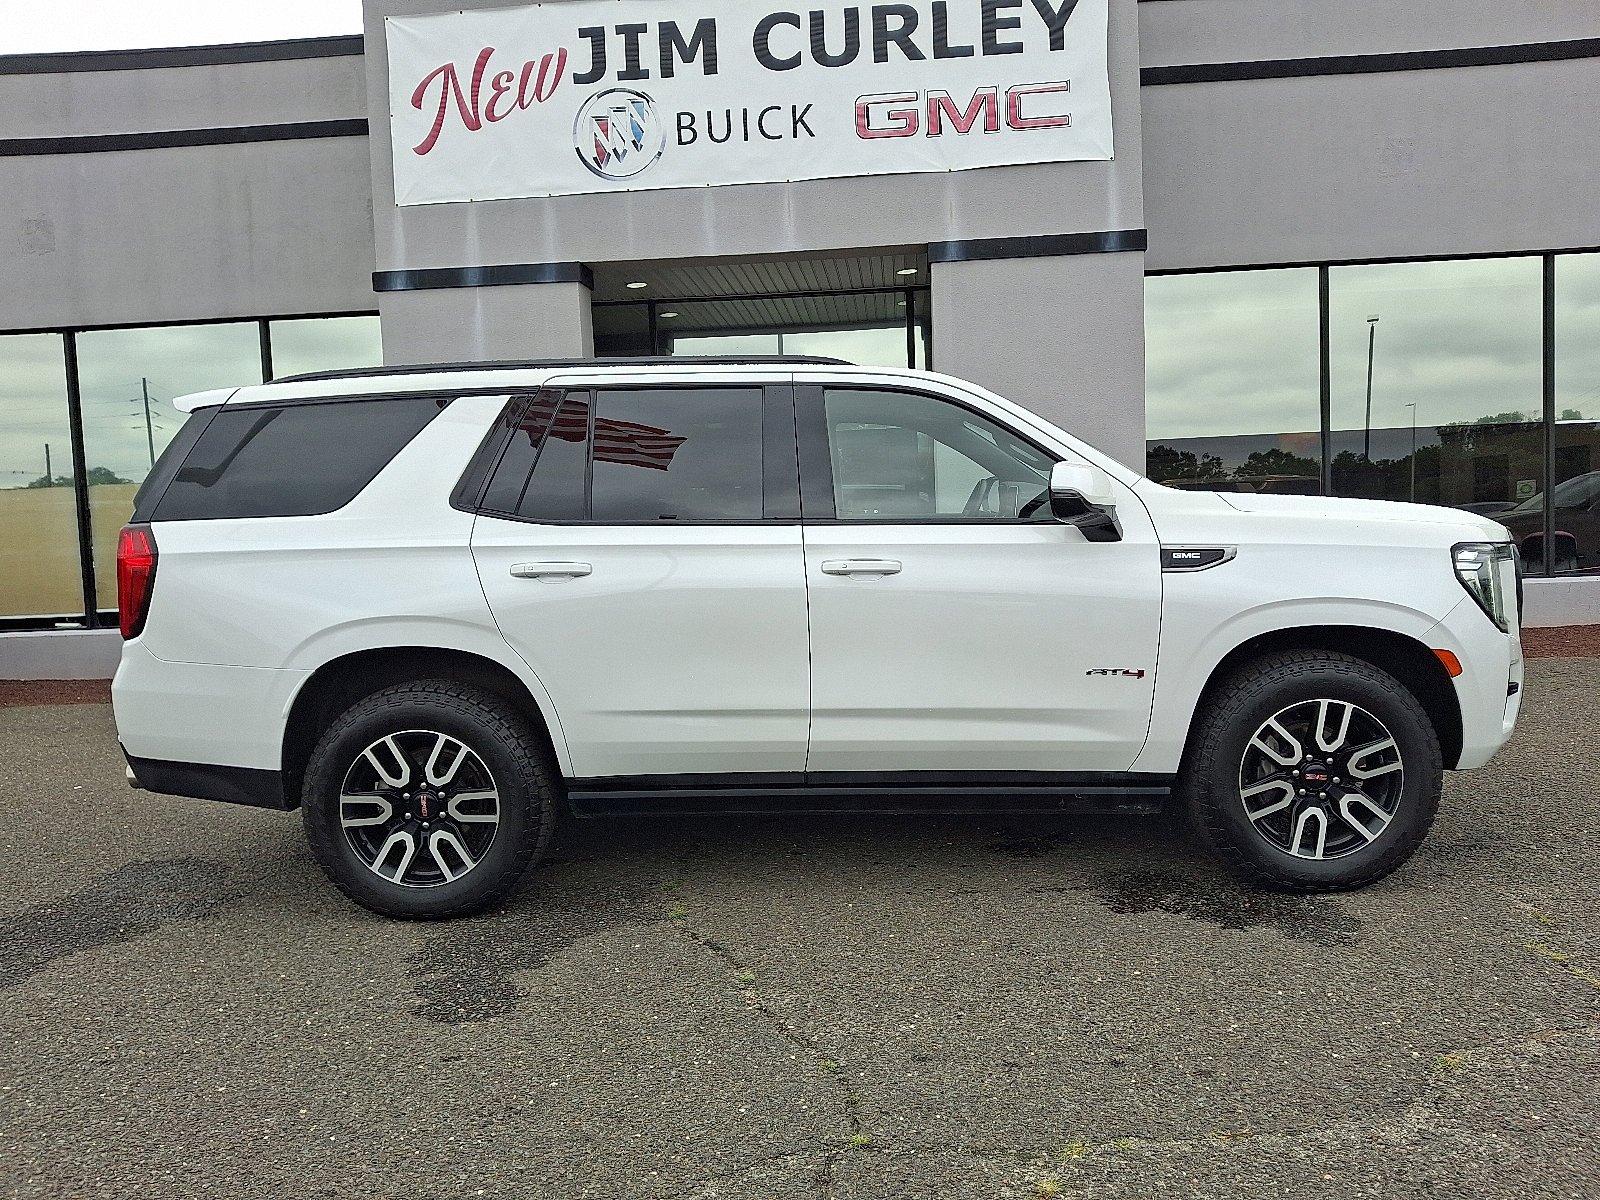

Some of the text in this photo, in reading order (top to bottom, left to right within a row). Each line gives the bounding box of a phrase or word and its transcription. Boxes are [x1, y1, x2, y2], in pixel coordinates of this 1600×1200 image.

[573, 17, 719, 85] JIM
[752, 0, 1079, 71] CURLEY
[676, 103, 816, 146] BUICK
[854, 79, 1072, 140] GMC
[1085, 668, 1145, 679] AT4
